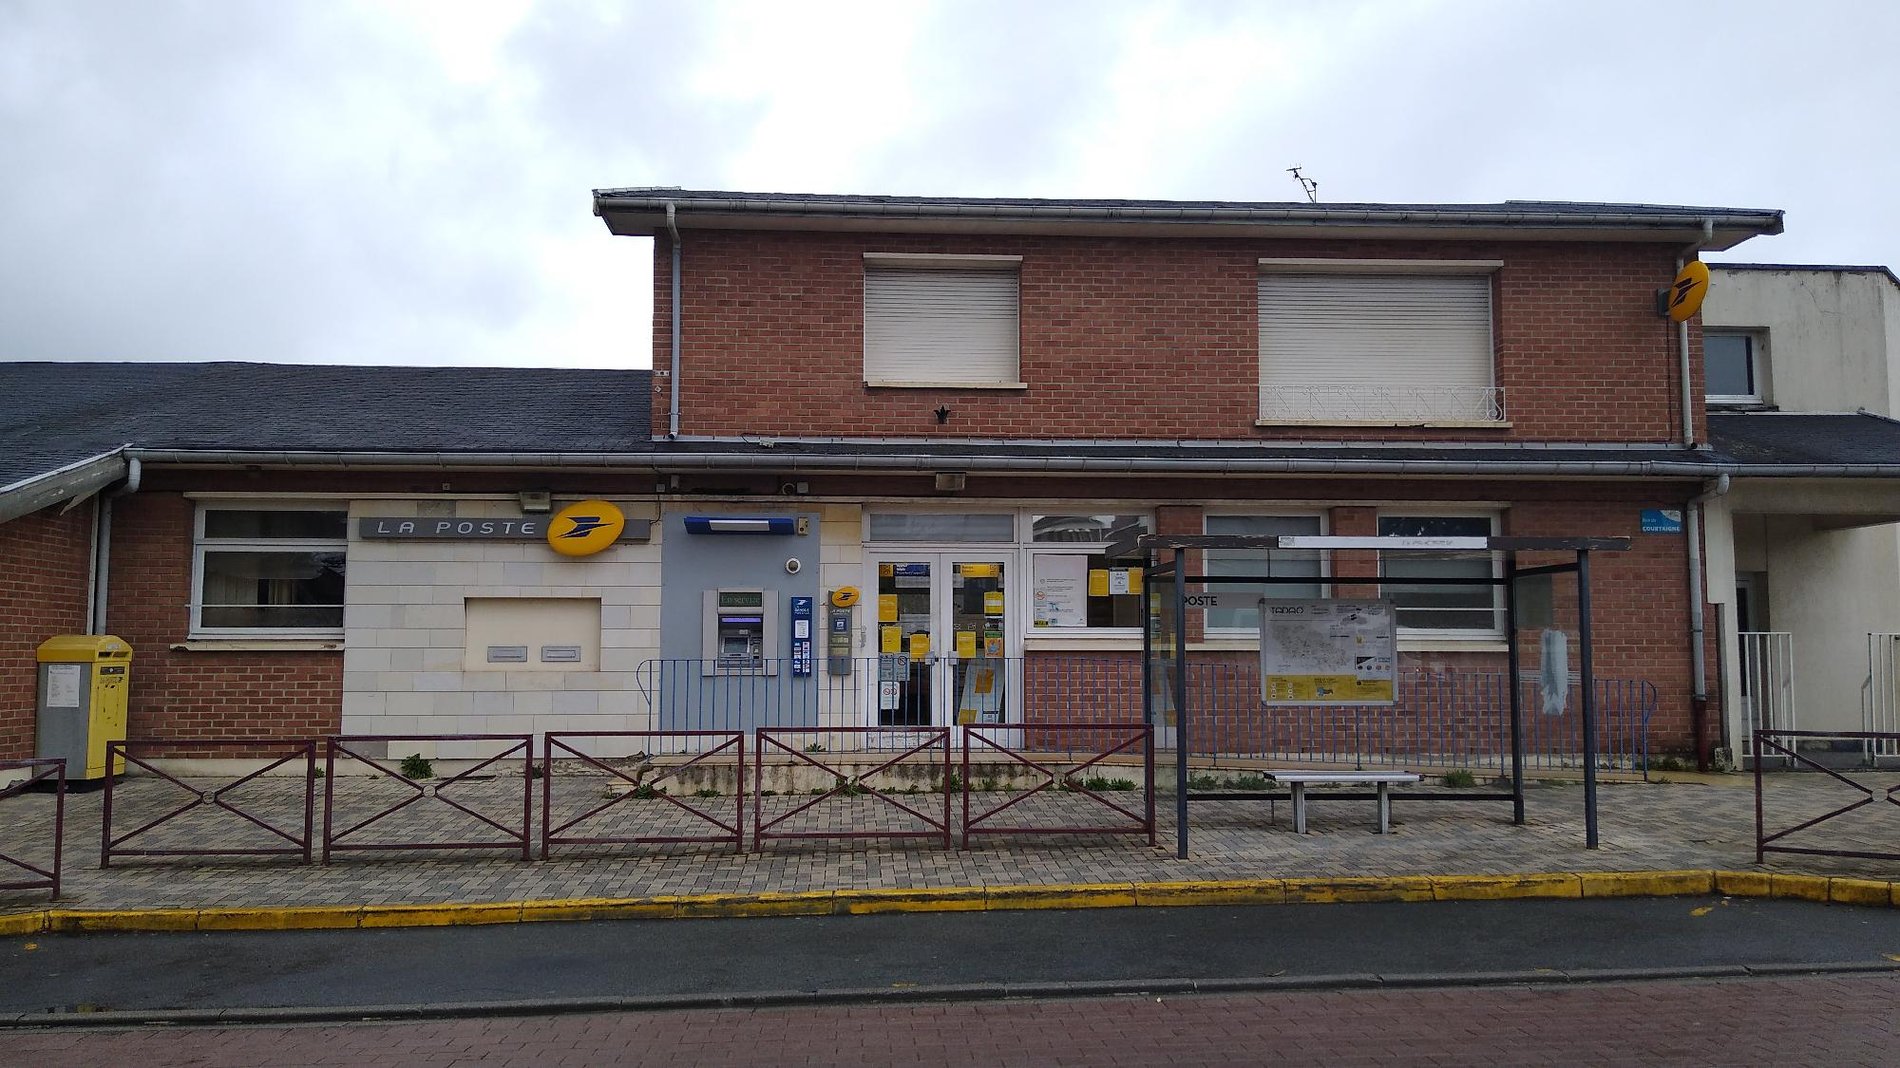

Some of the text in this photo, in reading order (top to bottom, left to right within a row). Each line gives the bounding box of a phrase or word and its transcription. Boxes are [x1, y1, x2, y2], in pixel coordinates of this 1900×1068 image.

[377, 521, 537, 534] LA POSTE
[1271, 606, 1304, 614] TADAO
